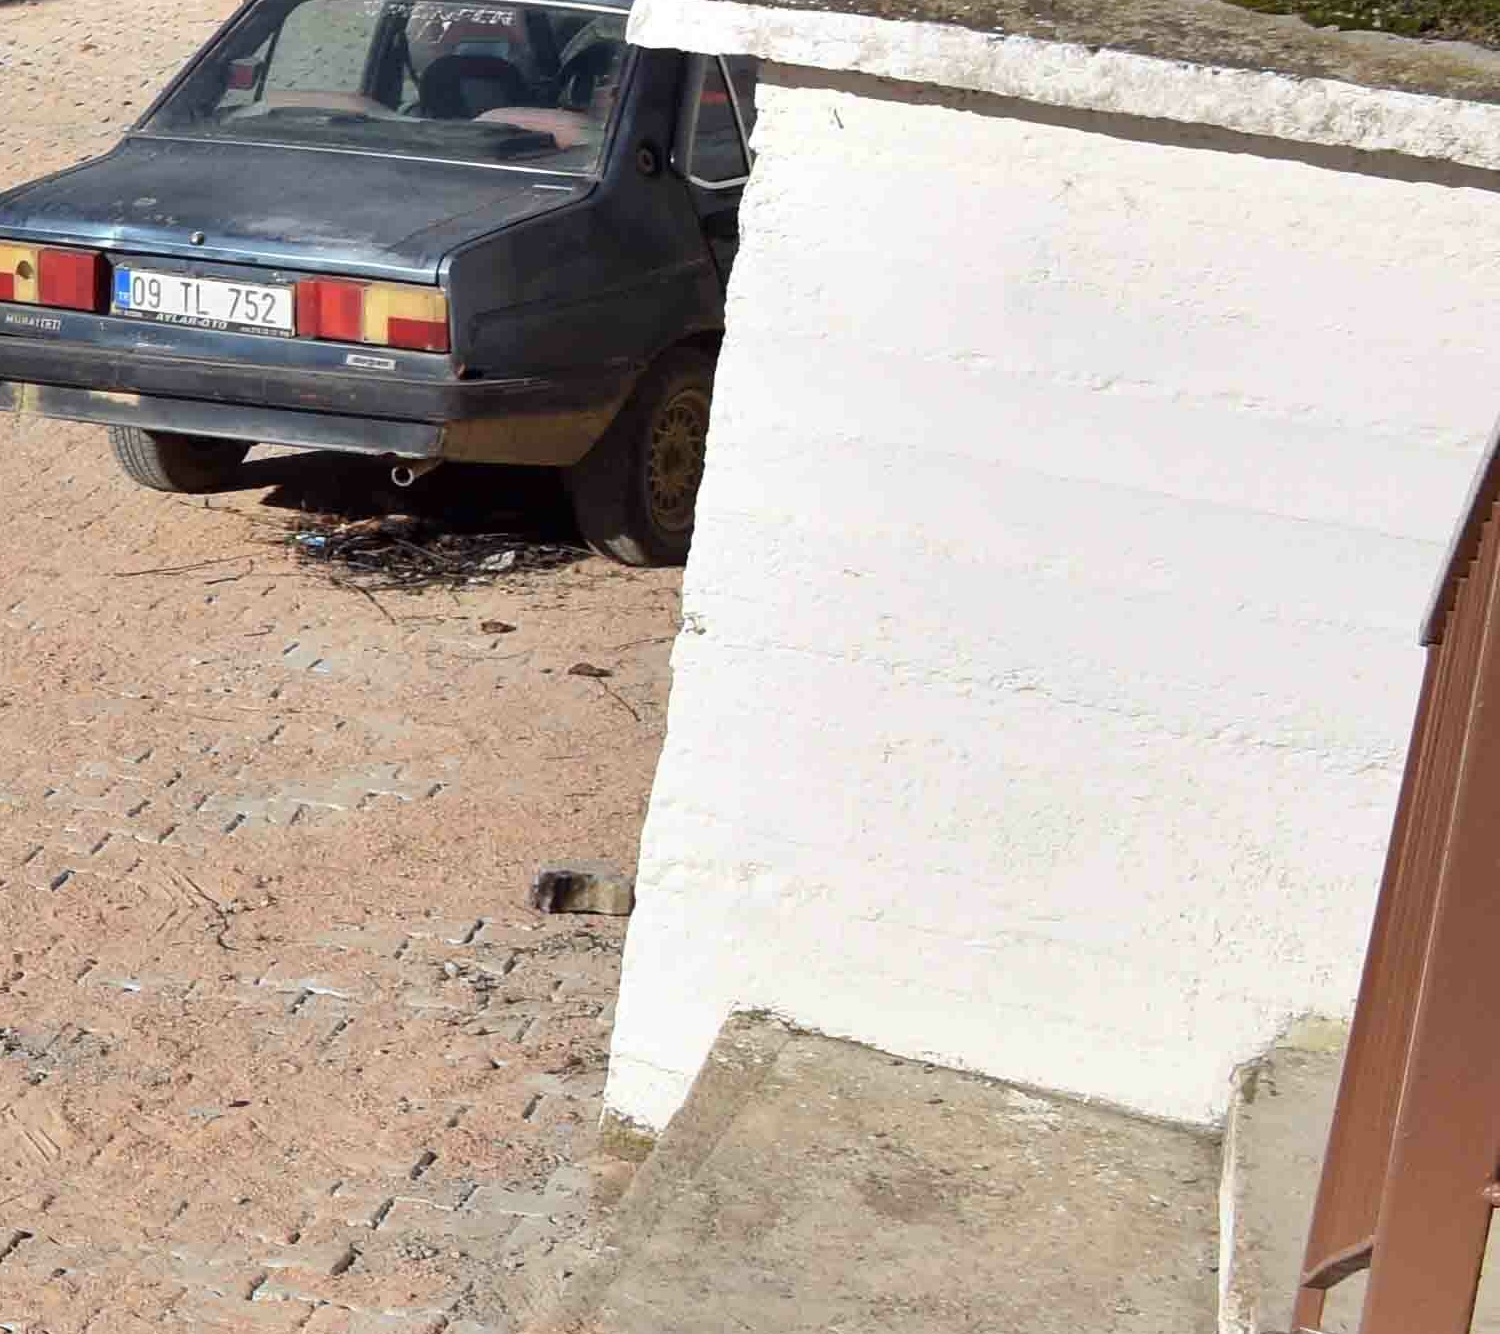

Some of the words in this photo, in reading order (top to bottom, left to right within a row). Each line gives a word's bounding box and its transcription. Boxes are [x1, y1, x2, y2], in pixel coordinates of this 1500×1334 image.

[132, 276, 162, 309] 09
[180, 282, 210, 315] TL
[228, 288, 277, 324] 752
